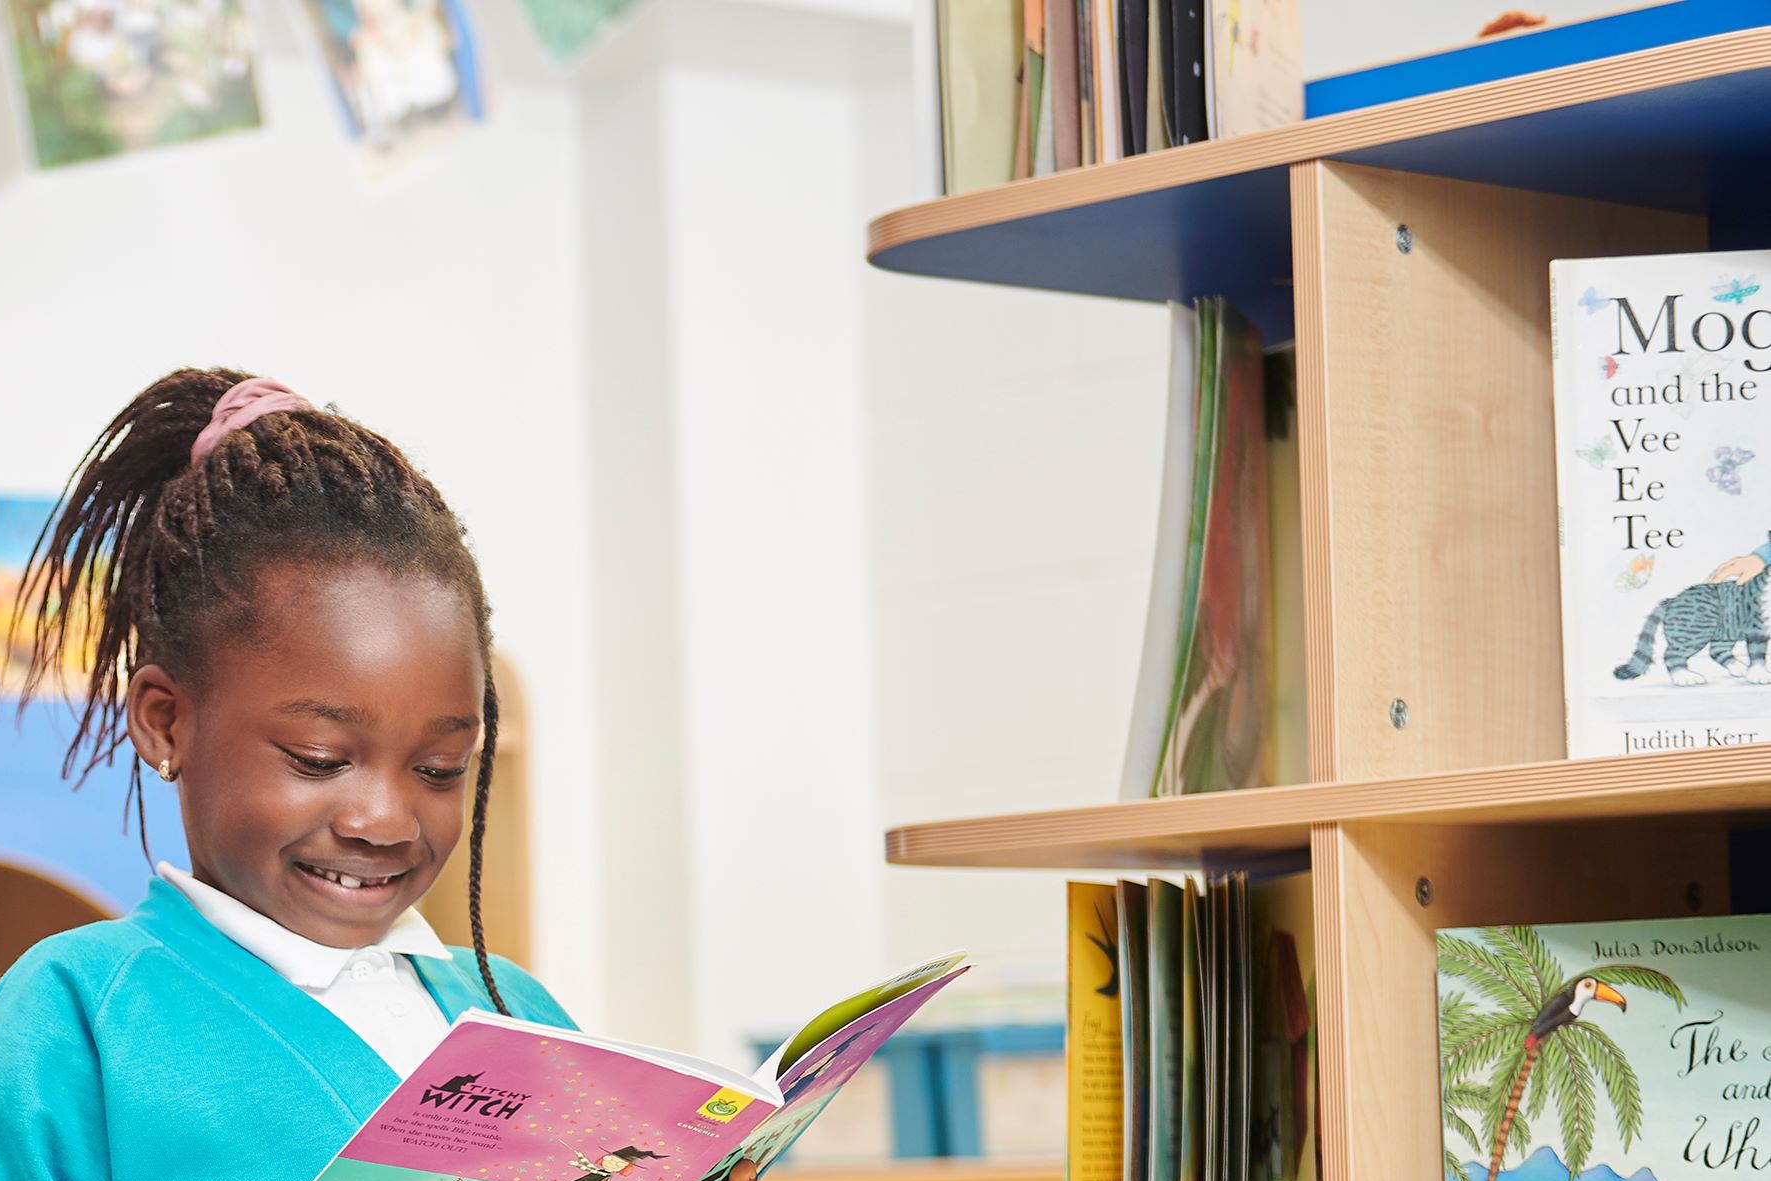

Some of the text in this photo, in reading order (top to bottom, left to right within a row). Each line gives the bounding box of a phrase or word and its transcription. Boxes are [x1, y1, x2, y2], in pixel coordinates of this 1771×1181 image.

[1609, 294, 1771, 372] Mog
[1611, 373, 1757, 406] and the
[1609, 418, 1680, 453] Vee
[1613, 467, 1664, 502] Ee
[1613, 514, 1684, 550] Tee
[1624, 728, 1758, 754] Judith Kerr
[1591, 932, 1762, 961] Julia Donaldson
[1670, 1008, 1748, 1079] The
[469, 1084, 532, 1101] TITCHY
[1722, 1075, 1771, 1101] and
[420, 1089, 524, 1120] WITCH
[380, 1123, 406, 1133] When
[470, 1140, 497, 1149] wand
[452, 1117, 472, 1125] little
[403, 1137, 469, 1153] WATCH OUT!
[1684, 1114, 1771, 1171] Wh
